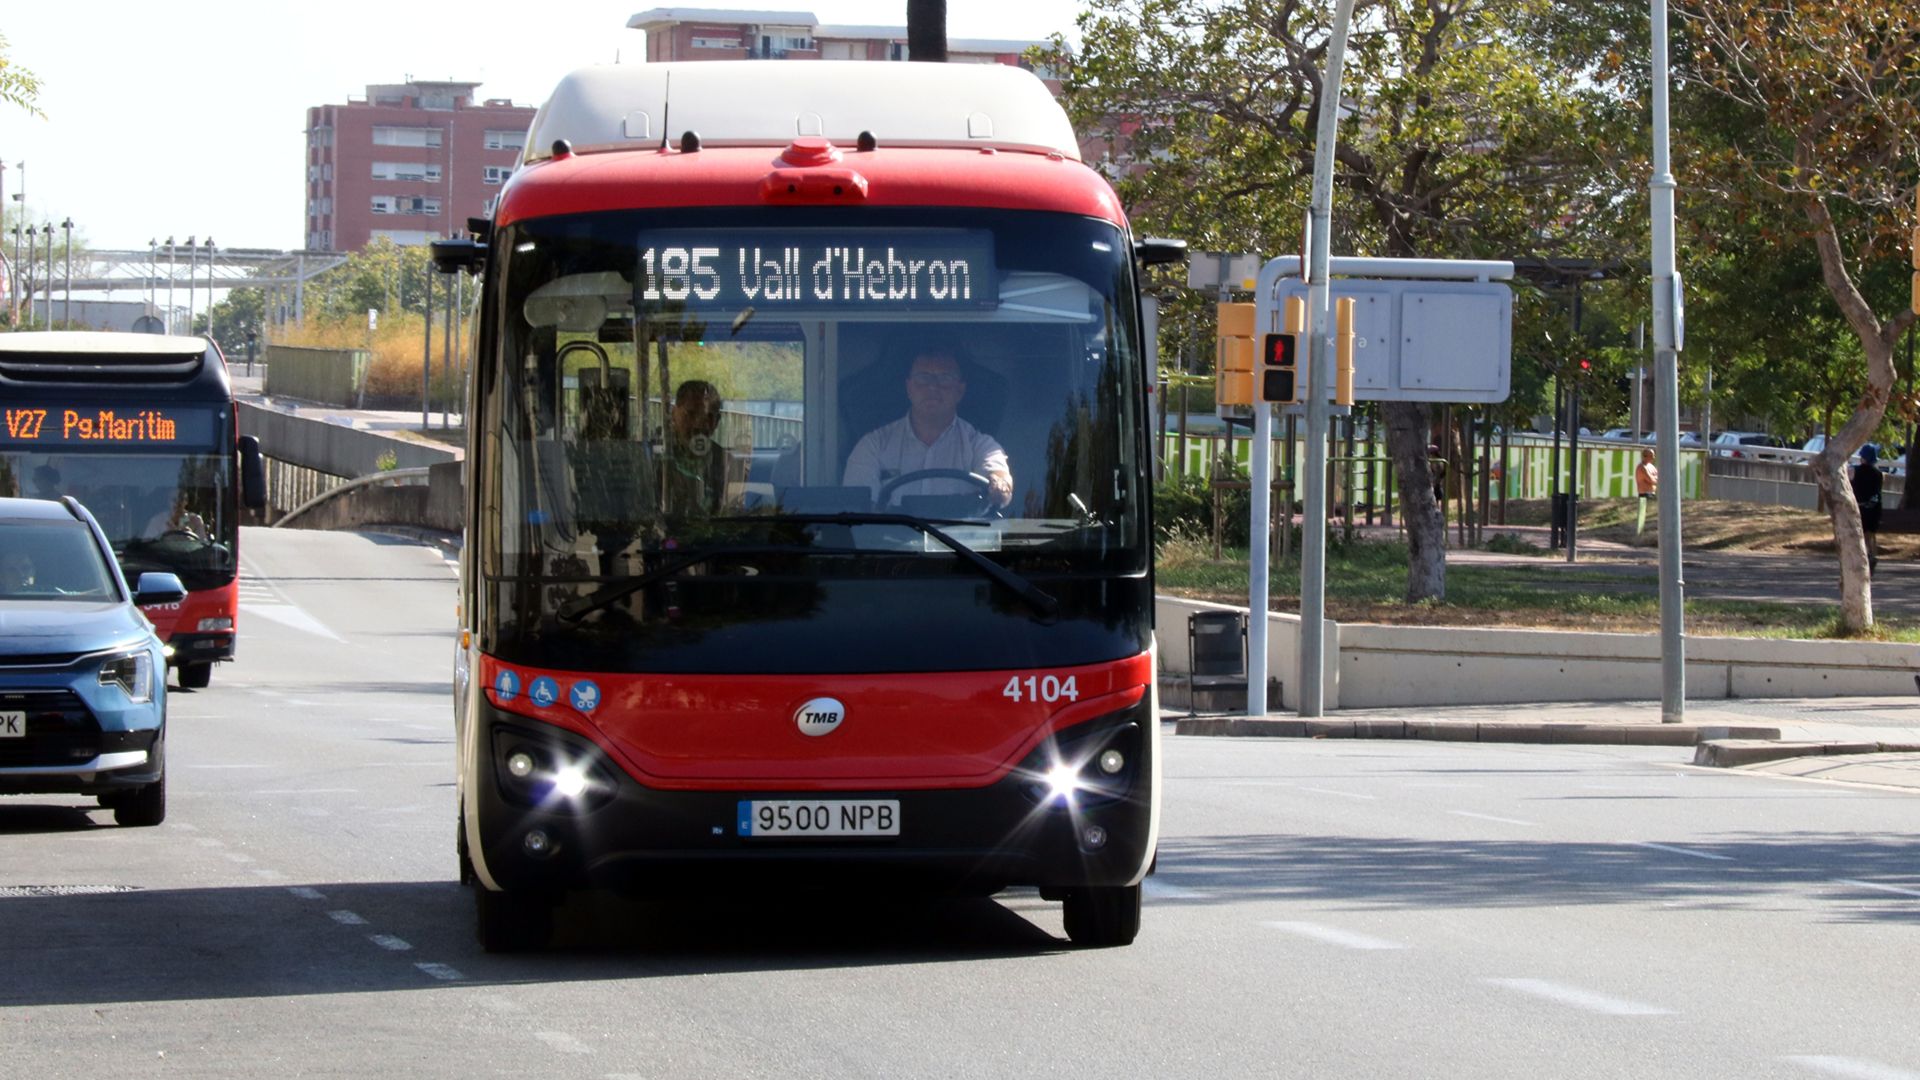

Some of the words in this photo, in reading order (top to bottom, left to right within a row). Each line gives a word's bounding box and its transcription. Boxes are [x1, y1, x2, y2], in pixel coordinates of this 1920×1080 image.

[642, 247, 721, 300] 185
[739, 247, 801, 300] Vall
[812, 247, 971, 300] d'Hebron
[6, 409, 47, 438] V27
[63, 410, 176, 440] Pg.Marítim
[1002, 674, 1080, 703] 4104
[805, 712, 838, 724] TMB
[758, 805, 830, 831] 9500
[840, 804, 893, 831] NPB
